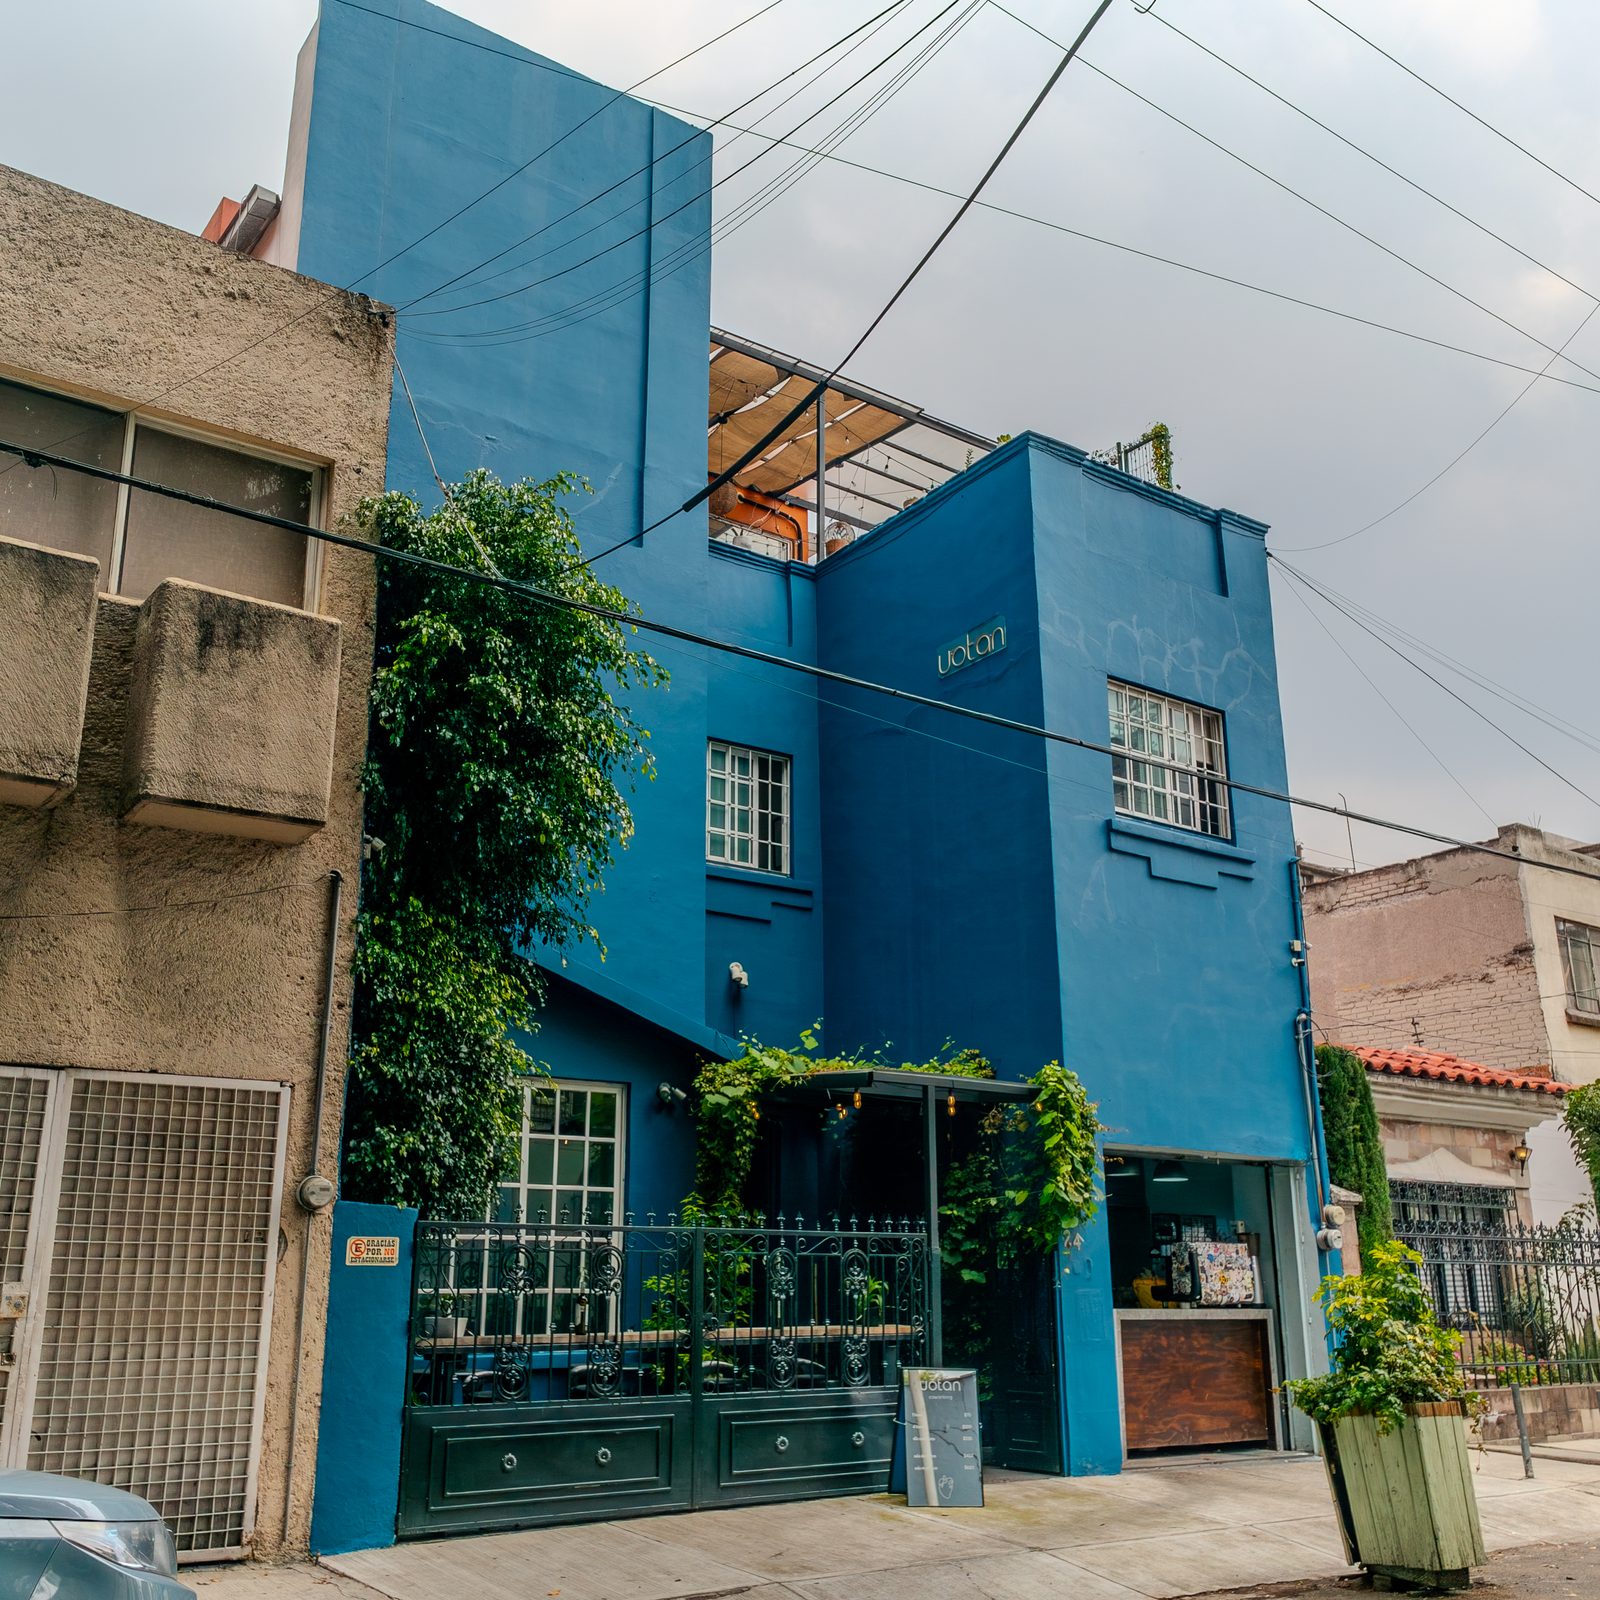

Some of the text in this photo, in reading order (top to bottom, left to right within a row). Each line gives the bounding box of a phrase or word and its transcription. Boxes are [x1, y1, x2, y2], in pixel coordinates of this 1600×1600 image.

[366, 1239, 396, 1248] GRACIAS
[366, 1248, 395, 1256] POR NO
